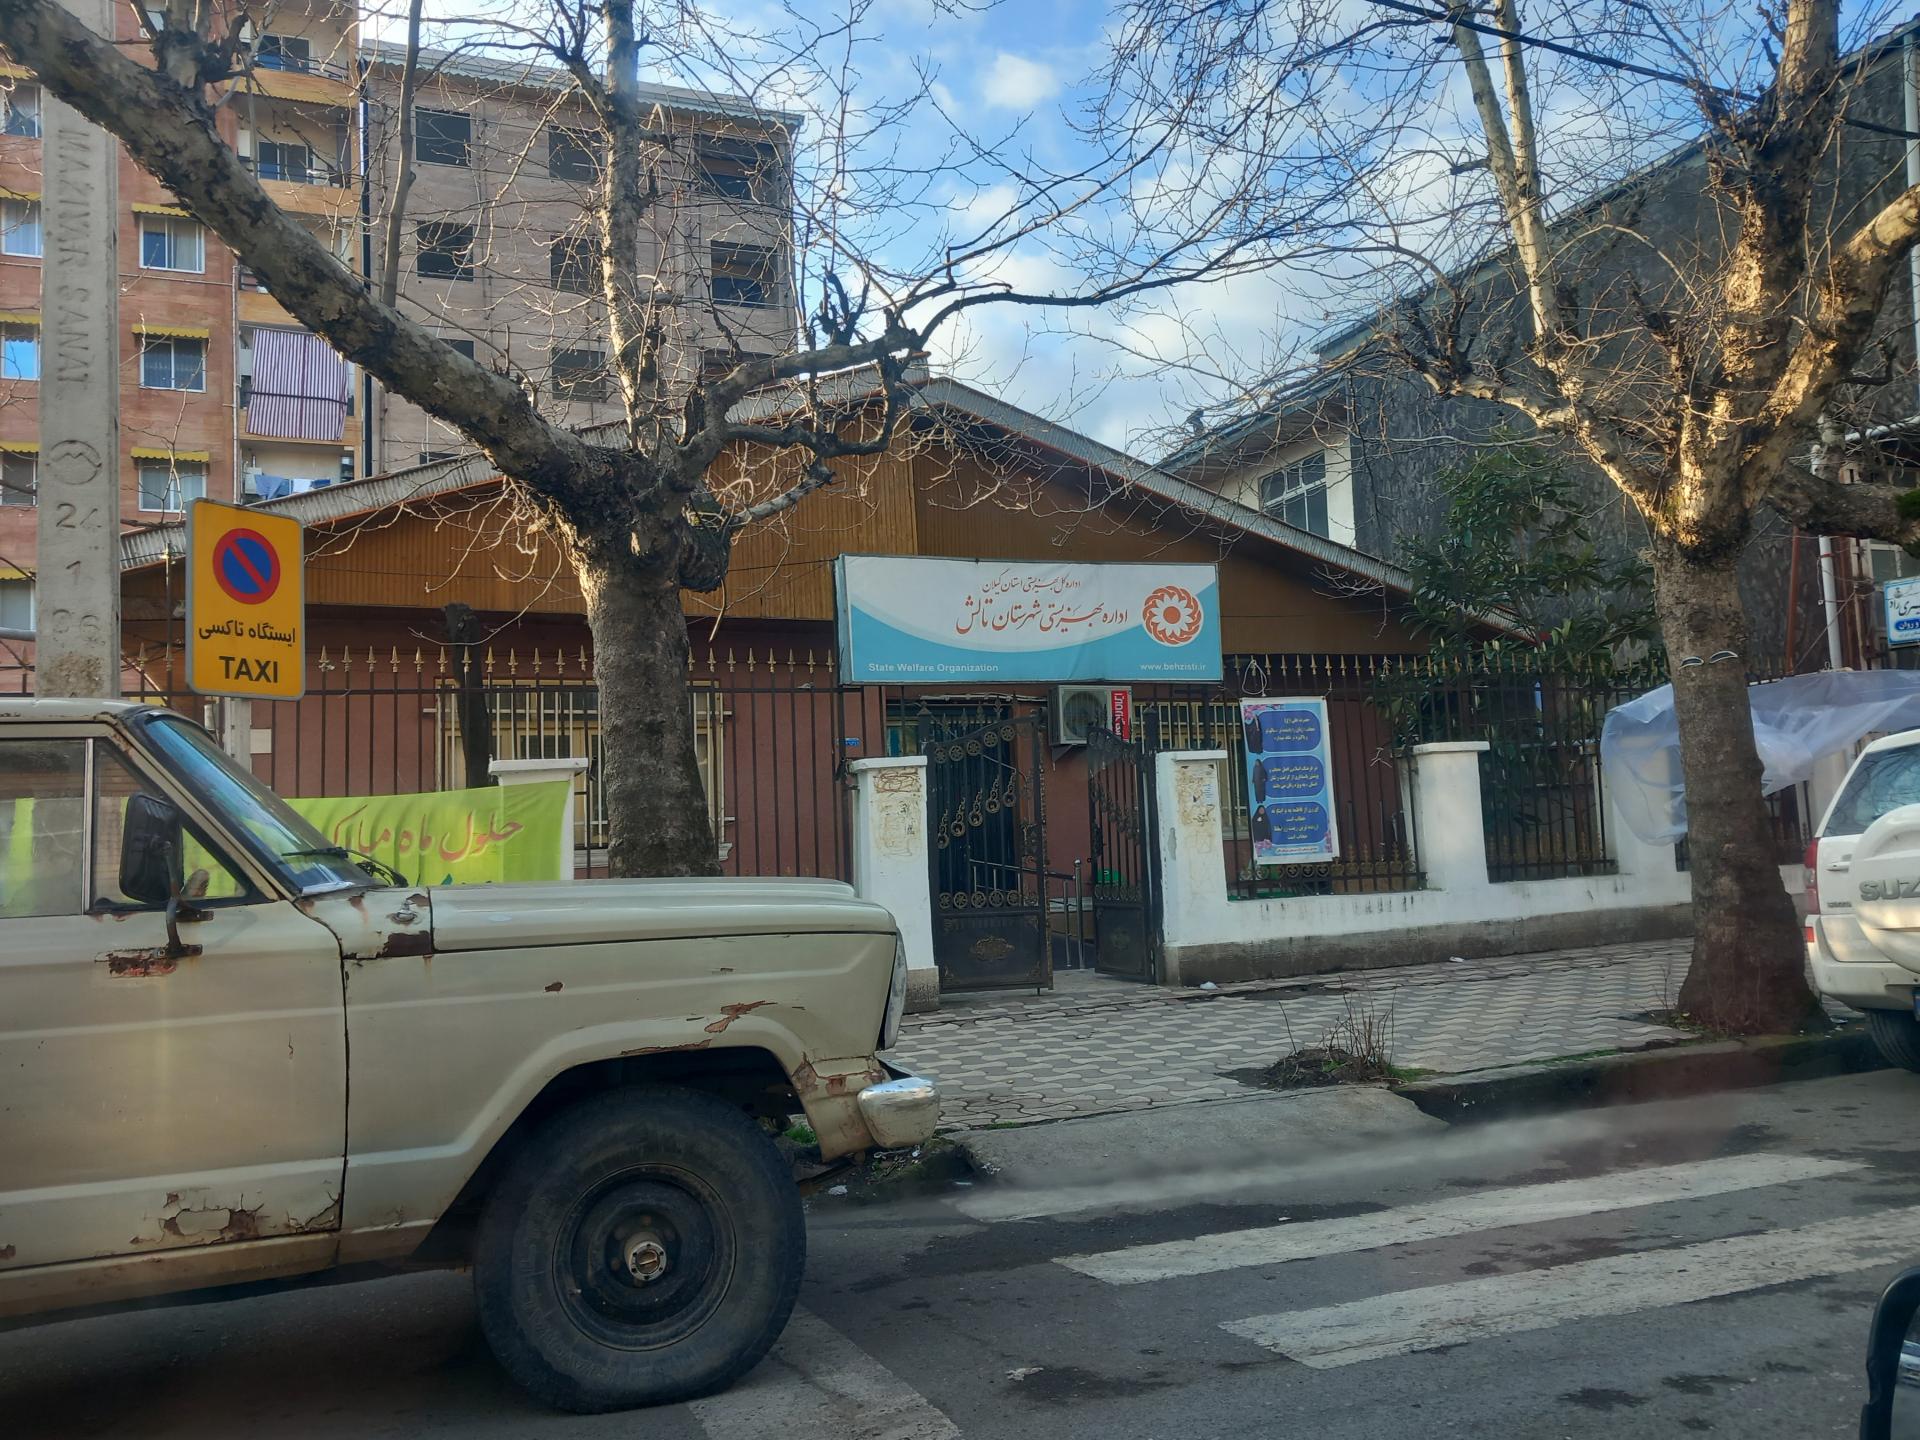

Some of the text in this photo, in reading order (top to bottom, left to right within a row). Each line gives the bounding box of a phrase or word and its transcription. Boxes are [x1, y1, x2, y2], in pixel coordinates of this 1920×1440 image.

[981, 567, 1010, 595] گیلان
[1000, 577, 1023, 592] استان
[1022, 576, 1060, 593] بهزیستی
[1065, 578, 1081, 588] اداره
[955, 594, 1128, 635] اداره بهزیستی شهرستان تالش
[198, 619, 296, 647] ایستگاه تاکسی
[218, 654, 279, 684] TAXI
[868, 663, 999, 674] State Welfare Organization
[1140, 662, 1206, 671] www.behzisti.ir
[399, 812, 433, 852] ماه
[438, 807, 524, 863] حلول
